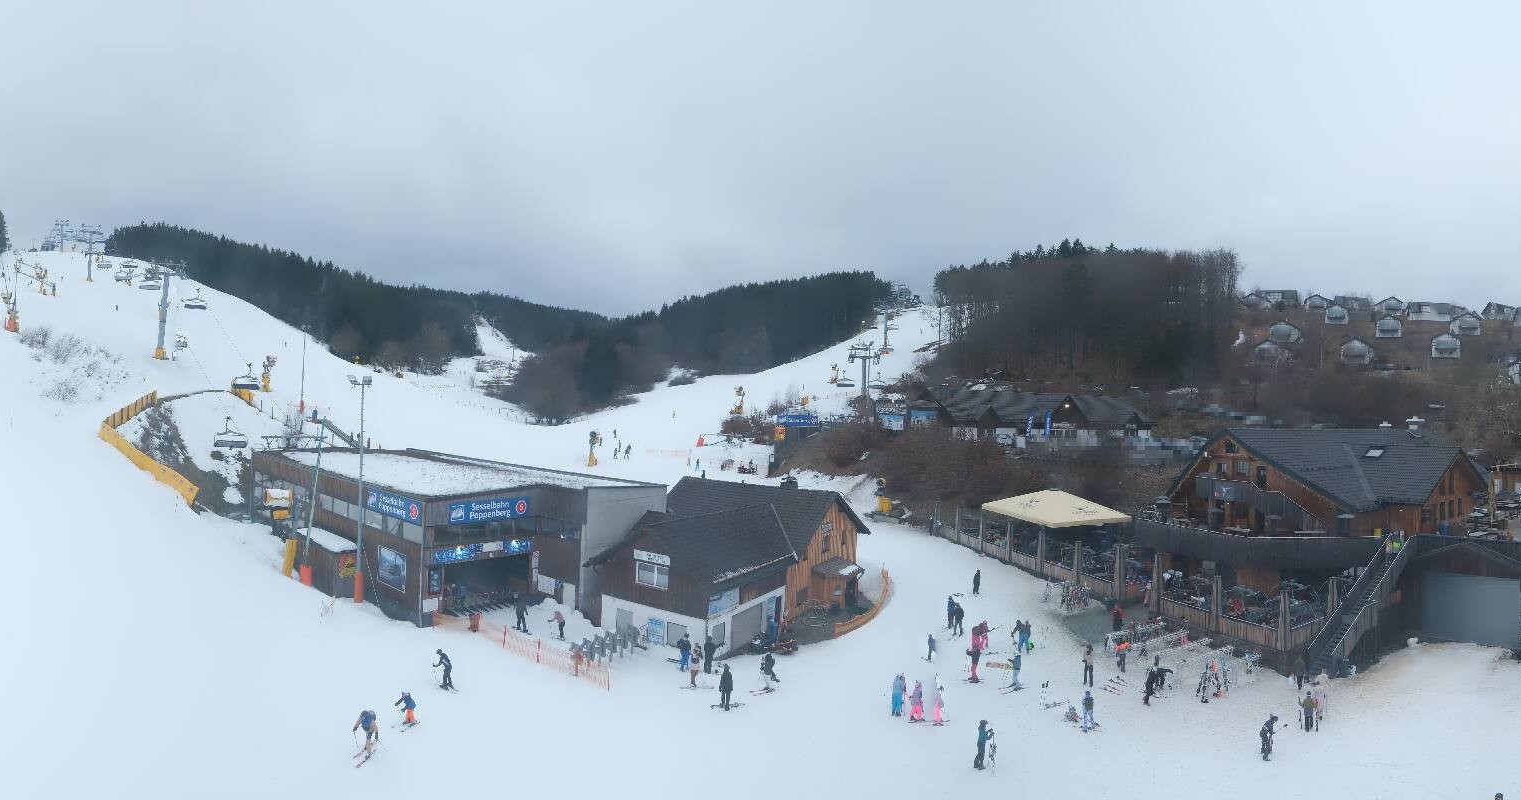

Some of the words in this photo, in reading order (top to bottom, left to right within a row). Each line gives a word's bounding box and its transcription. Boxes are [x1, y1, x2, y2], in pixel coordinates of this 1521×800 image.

[378, 502, 406, 518] Poppenberg
[471, 500, 510, 511] Sesselbahn
[469, 509, 511, 520] Poppenberg
